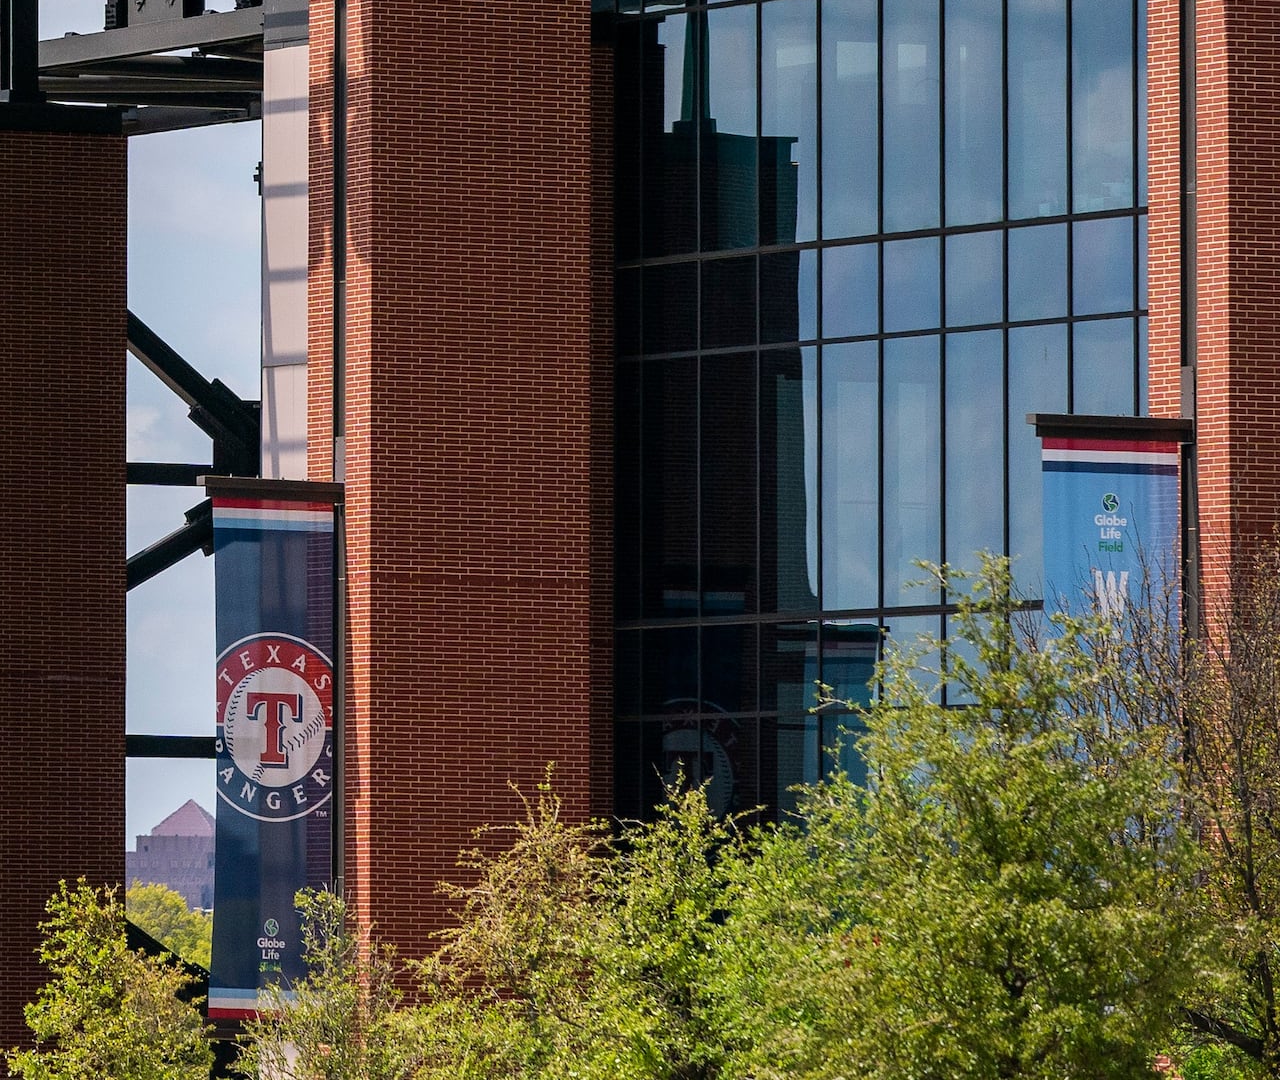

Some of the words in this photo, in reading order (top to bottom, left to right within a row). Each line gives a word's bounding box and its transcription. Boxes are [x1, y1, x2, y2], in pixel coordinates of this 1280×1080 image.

[1094, 514, 1128, 527] Globe
[1100, 527, 1122, 539] Life
[1098, 541, 1124, 553] Field
[218, 644, 332, 690] TEXAS
[257, 937, 286, 949] Globe
[262, 949, 280, 960] Life
